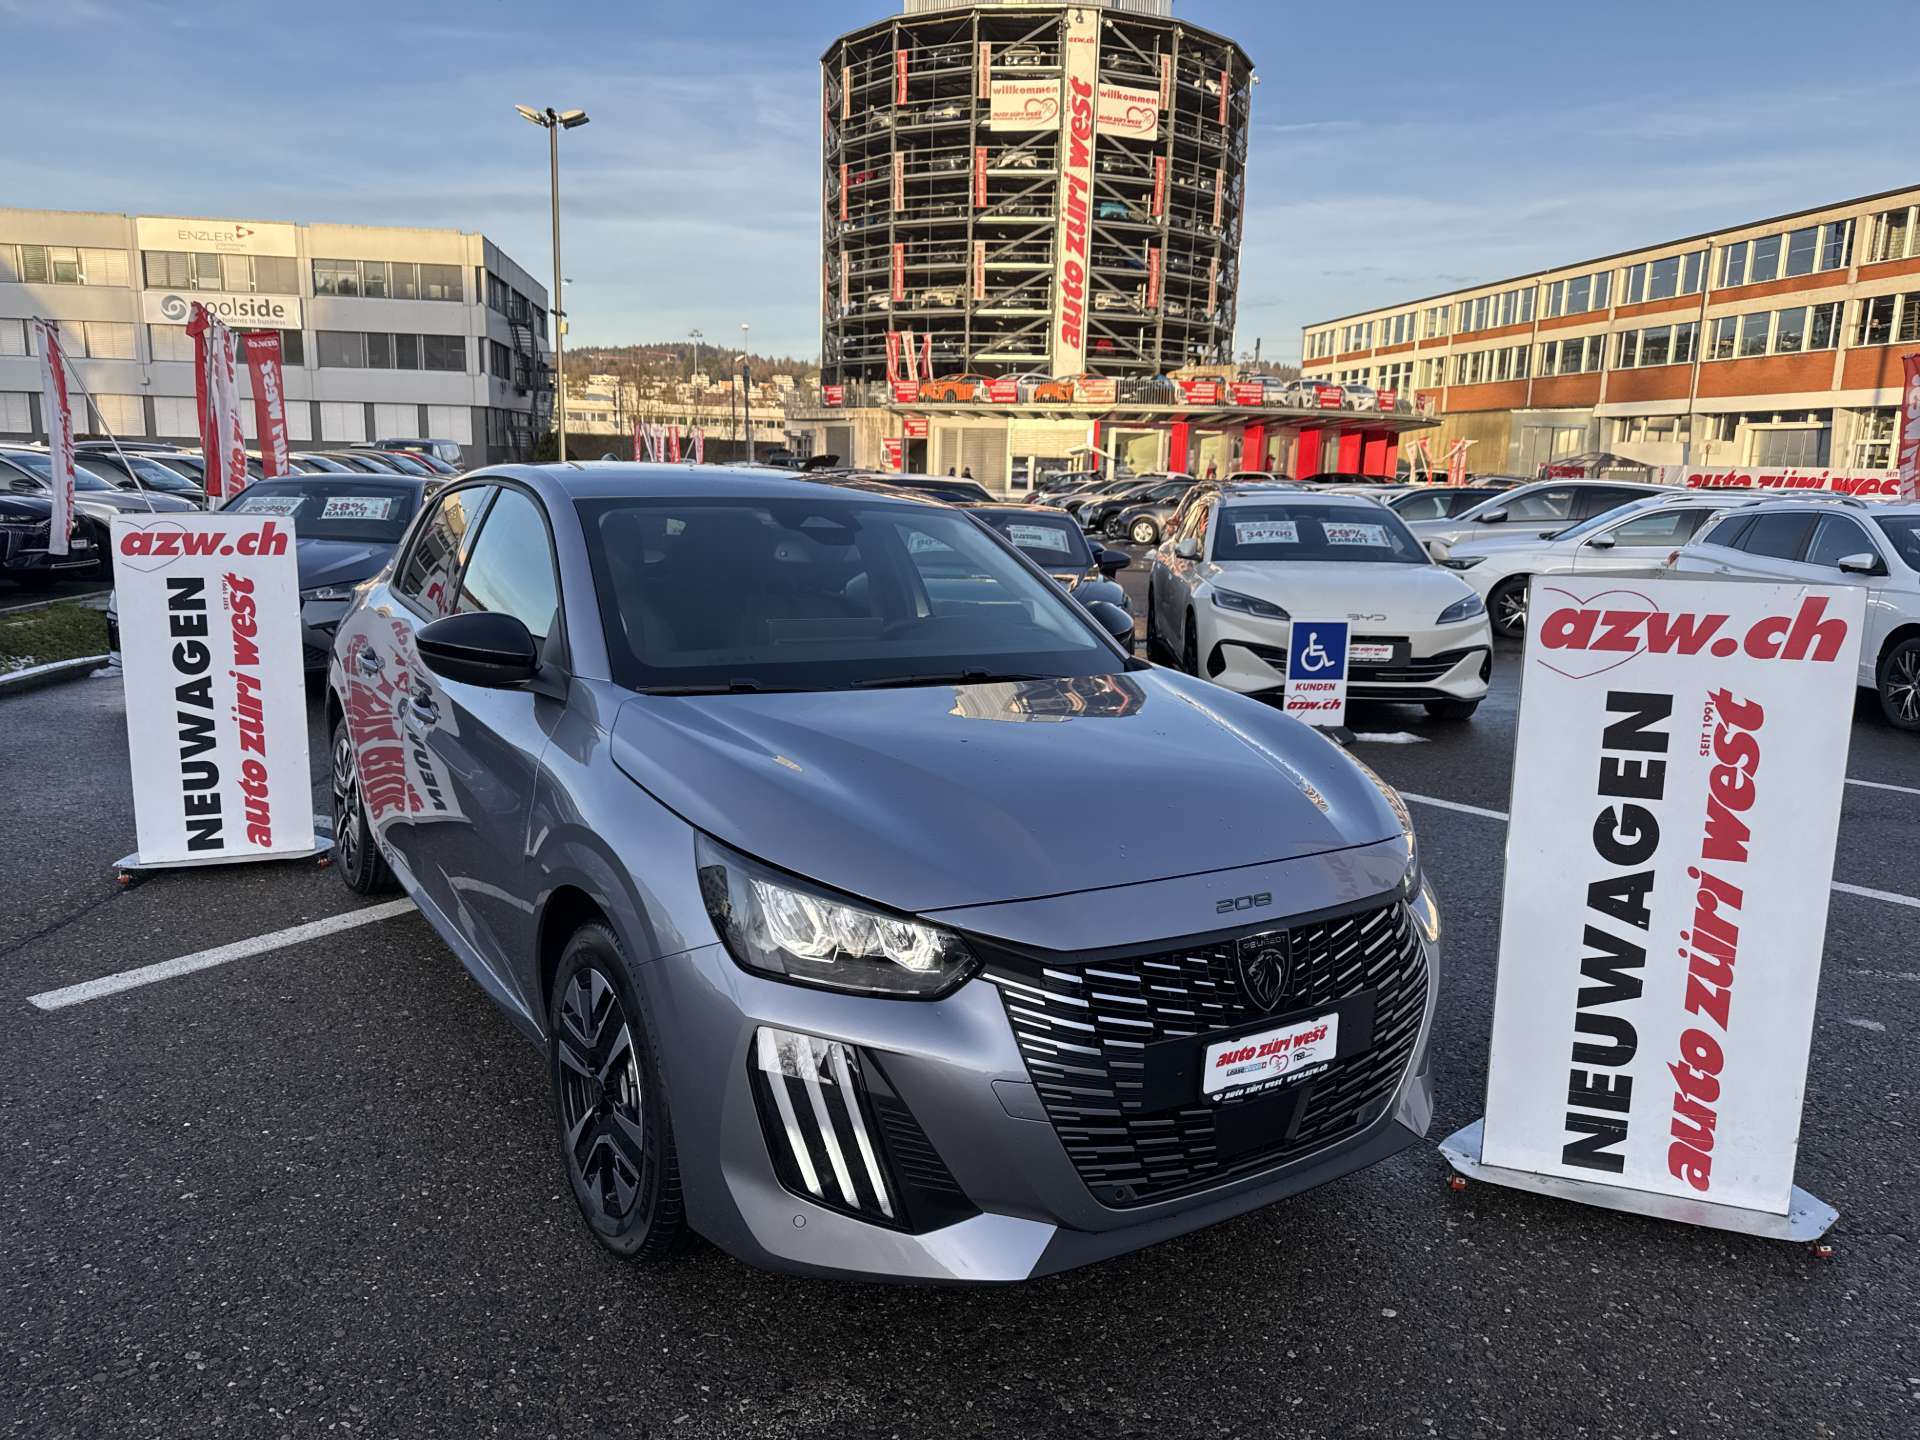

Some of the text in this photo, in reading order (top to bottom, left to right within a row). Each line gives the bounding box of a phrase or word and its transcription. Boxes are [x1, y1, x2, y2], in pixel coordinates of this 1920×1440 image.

[993, 85, 1058, 95] willkommen
[1100, 89, 1157, 105] willkommen
[1061, 75, 1092, 350] auto züri west
[178, 230, 234, 242] ENZLER
[205, 297, 285, 317] oolside
[1831, 477, 1901, 496] wes
[327, 502, 368, 512] 38%
[120, 521, 288, 556] azw.ch
[1540, 596, 1848, 662] azw.ch
[1287, 698, 1342, 710] azw.ch
[1295, 683, 1336, 691] KUNDEN
[166, 577, 225, 852] NEUWAGEN
[222, 571, 273, 848] auto züri west
[1700, 700, 1715, 757] SEIT 1991
[1215, 892, 1272, 914] 208
[1561, 690, 1674, 1174] NEUWAGEN
[1666, 687, 1765, 1193] auto züri west
[1216, 1023, 1328, 1068] auto züri west
[1224, 1064, 1329, 1100] auto züri west www.azw.ch
